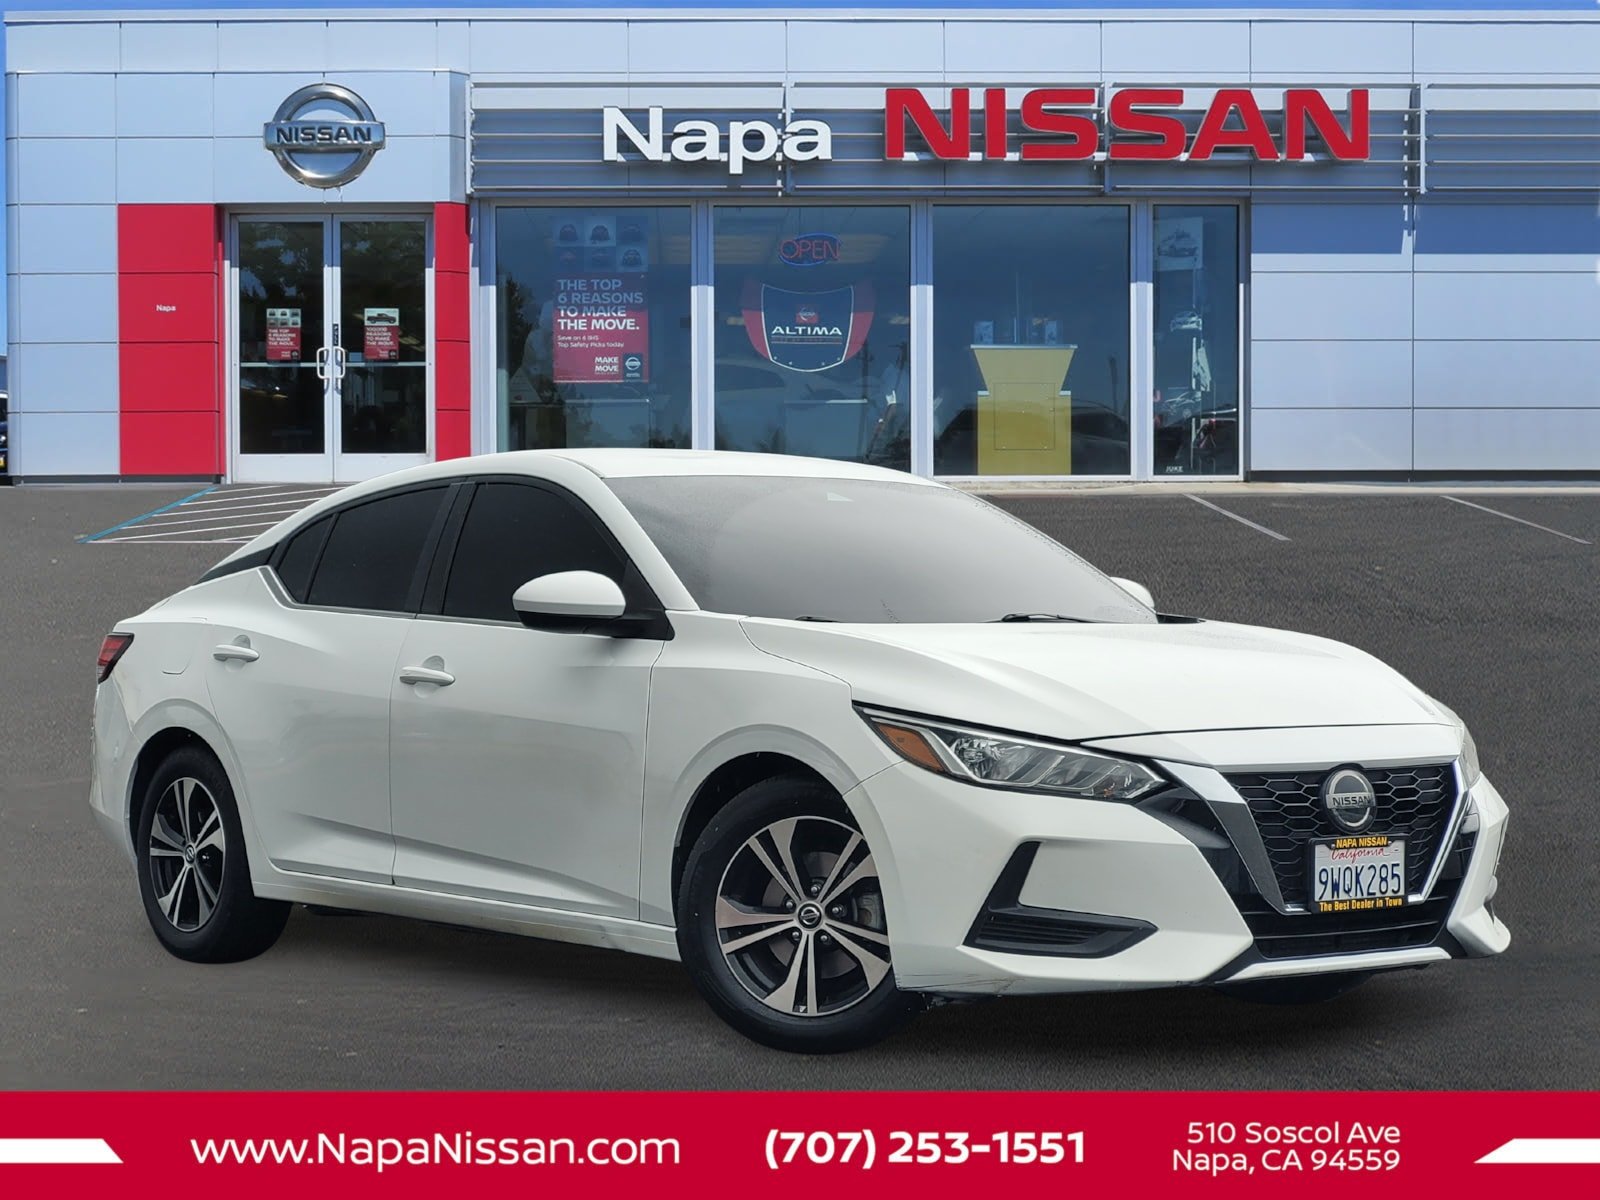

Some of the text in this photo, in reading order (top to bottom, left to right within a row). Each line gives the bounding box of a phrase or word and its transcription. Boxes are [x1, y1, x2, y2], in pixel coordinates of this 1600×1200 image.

[276, 126, 372, 144] NISSAN
[603, 87, 1370, 175] Napa NISSAN
[780, 239, 841, 261] OPEN
[557, 279, 622, 290] THE TOP
[557, 292, 644, 304] 6 REASONS
[156, 304, 176, 312] Napa
[557, 306, 627, 317] TO MAKE
[557, 319, 640, 330] THE MOVE.
[771, 326, 842, 335] ALTIMA
[1332, 795, 1372, 807] NISSAN
[1336, 837, 1388, 849] NAPA NISSAN
[1331, 848, 1390, 864] California
[1318, 863, 1401, 900] 9WQK285
[1320, 897, 1403, 912] The Best Dealer in Town
